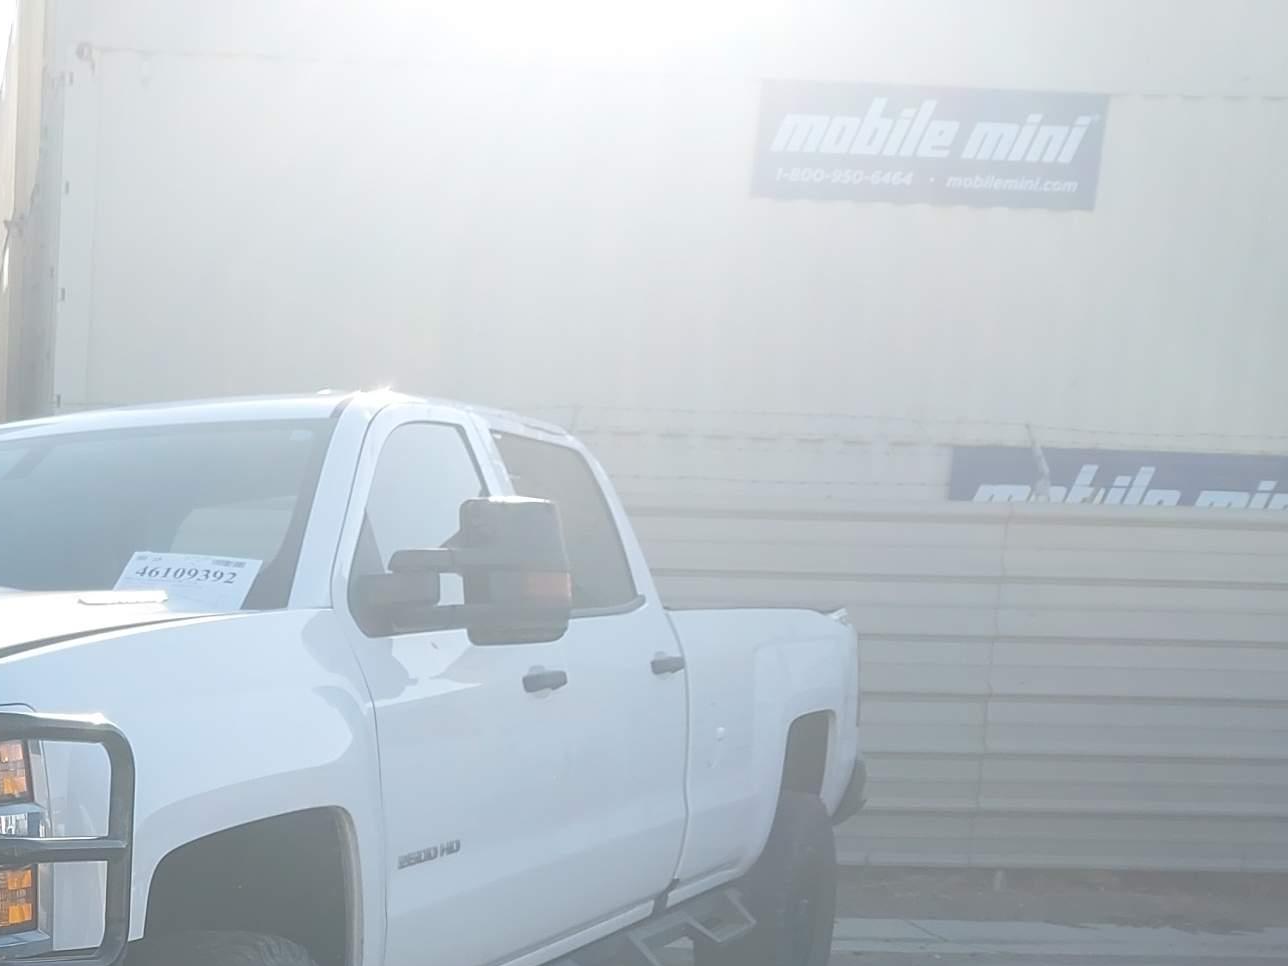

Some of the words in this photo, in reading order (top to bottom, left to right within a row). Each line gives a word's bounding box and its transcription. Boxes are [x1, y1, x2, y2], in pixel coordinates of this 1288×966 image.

[771, 97, 960, 158] mobile
[960, 113, 1092, 164] mini
[775, 167, 914, 186] 1-800-950-6464
[945, 174, 1078, 193] mobilemini.com
[135, 565, 237, 584] 46109392
